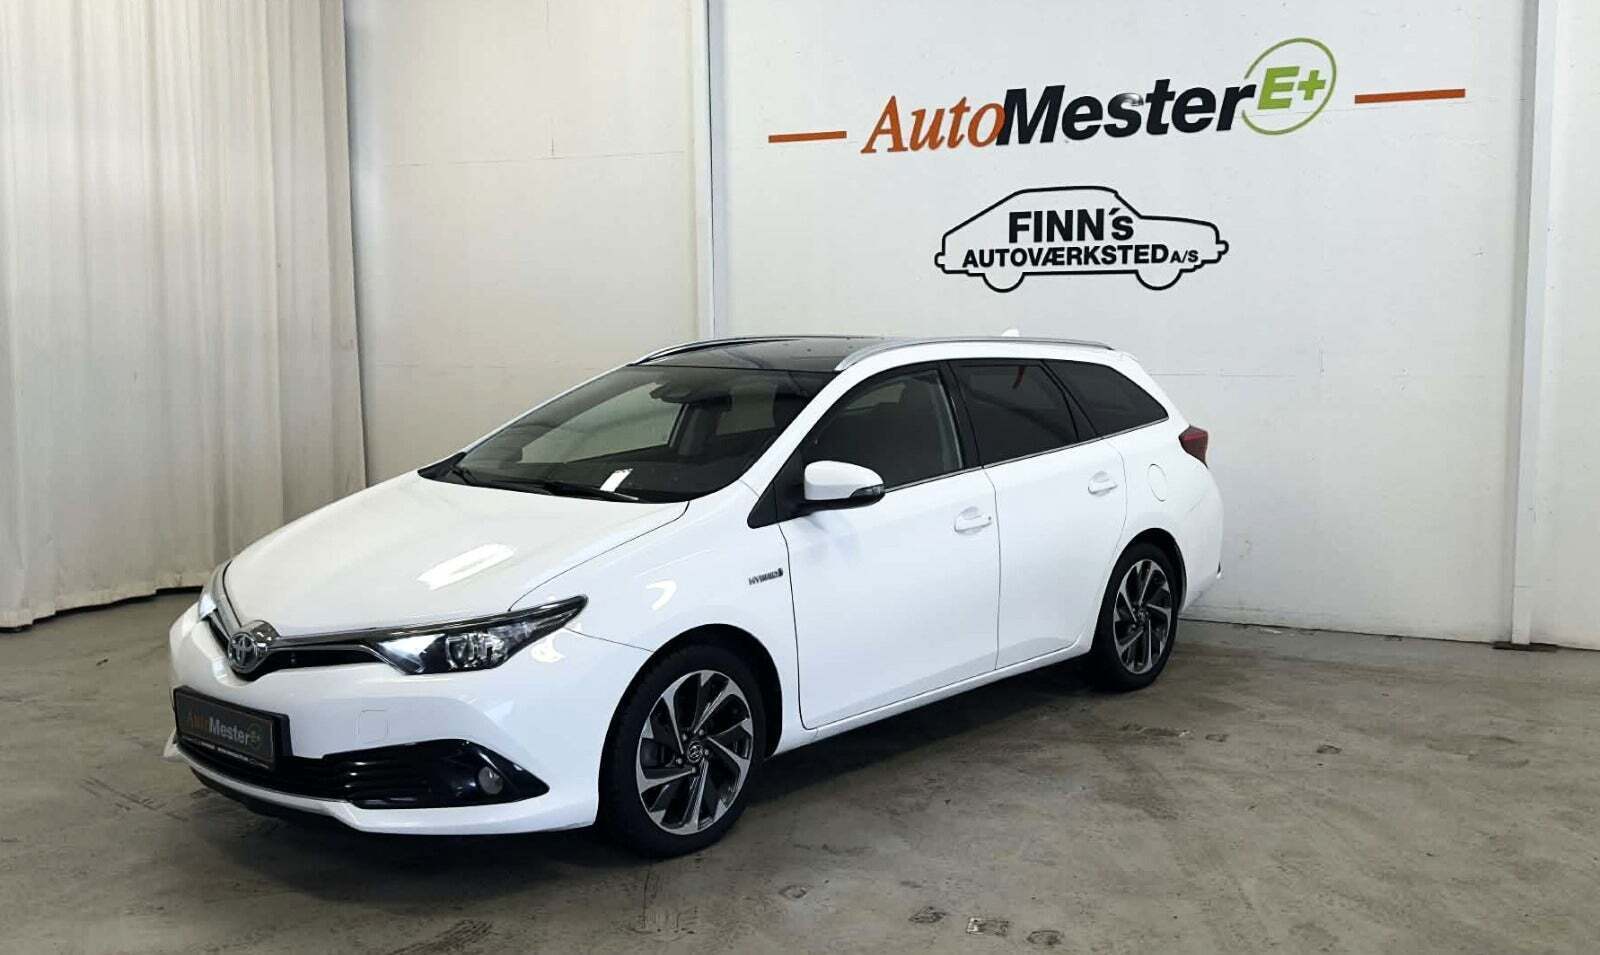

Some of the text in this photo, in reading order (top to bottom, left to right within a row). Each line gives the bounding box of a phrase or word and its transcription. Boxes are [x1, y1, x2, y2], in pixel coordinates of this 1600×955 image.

[861, 78, 1257, 154] AutoMester
[962, 244, 1199, 268] AUTOVÆRKSTED A/S
